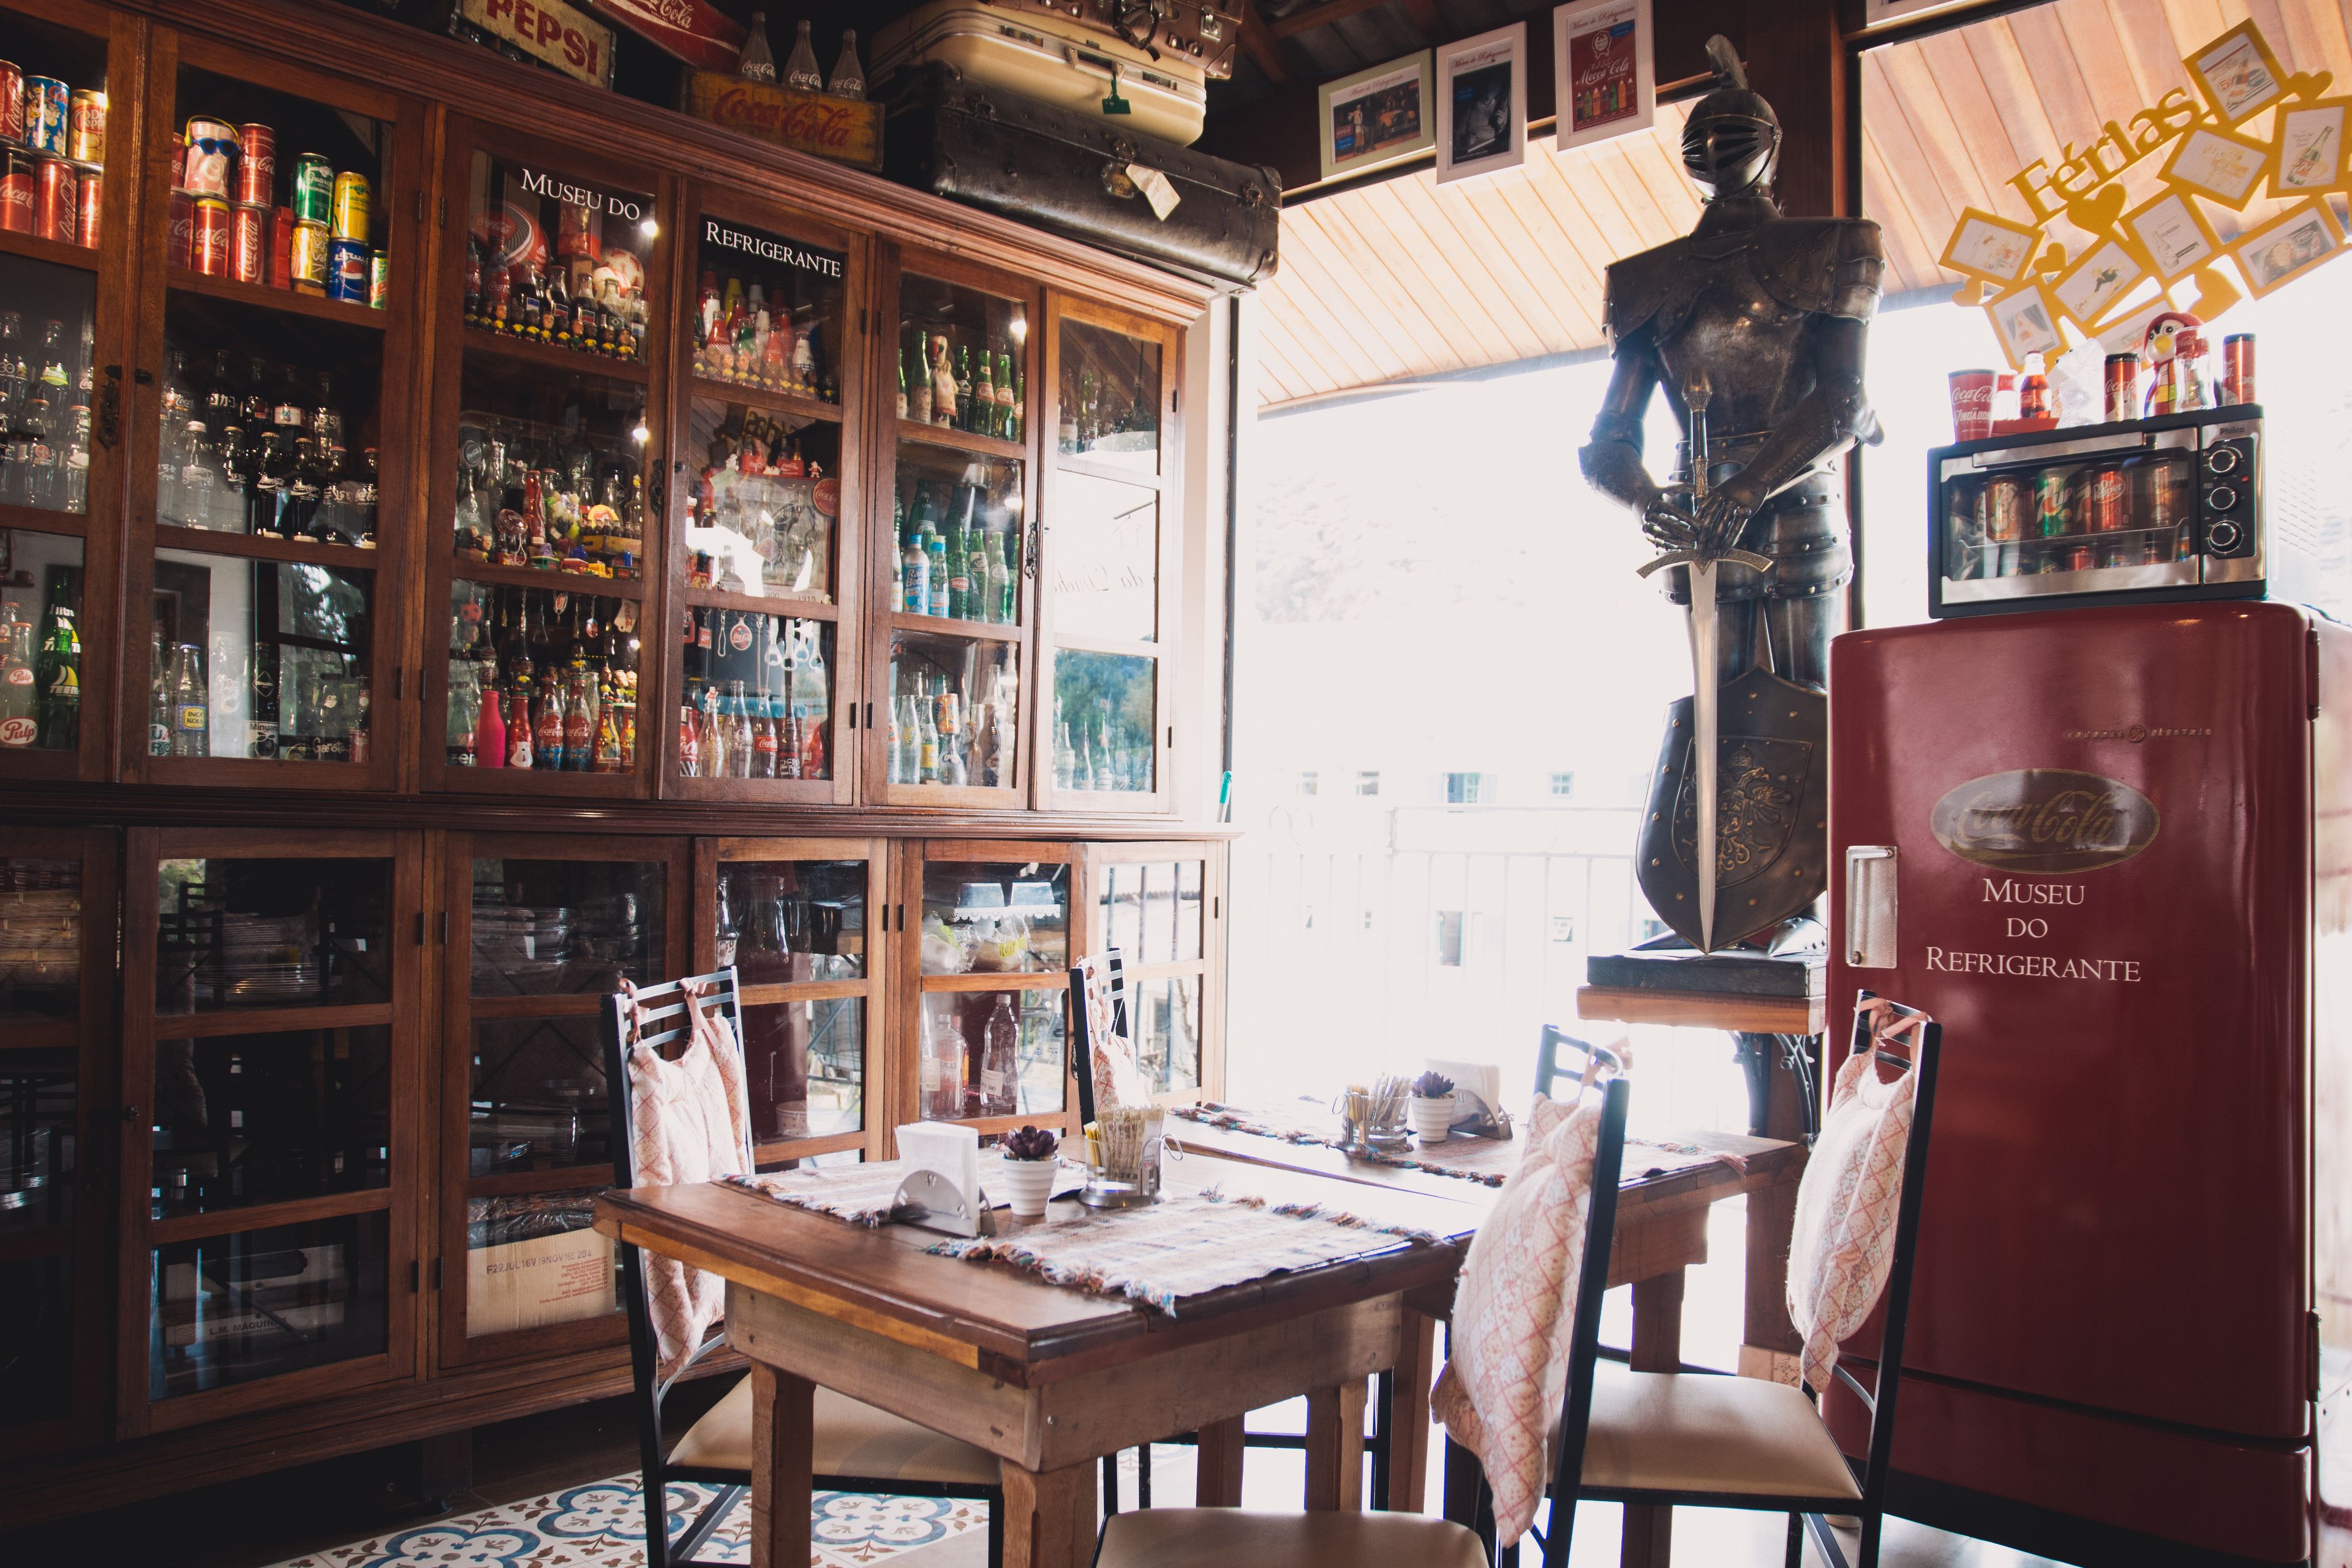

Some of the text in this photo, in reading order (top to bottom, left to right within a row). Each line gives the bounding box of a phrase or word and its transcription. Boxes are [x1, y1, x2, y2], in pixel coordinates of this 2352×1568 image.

[487, 0, 598, 75] PEPSI
[522, 168, 640, 221] MUSEU DO
[706, 221, 842, 278] REFRIGERANTE
[2093, 483, 2123, 502] Pepper
[2100, 480, 2113, 489] Dr
[13, 670, 31, 682] Pulp
[4, 721, 35, 742] Pulp
[451, 752, 475, 764] zer
[1958, 789, 2121, 843] Coca-Cola
[1982, 878, 2085, 905] MUSEU
[2006, 918, 2048, 938] DO
[1926, 946, 2141, 982] REFRIGERANTE
